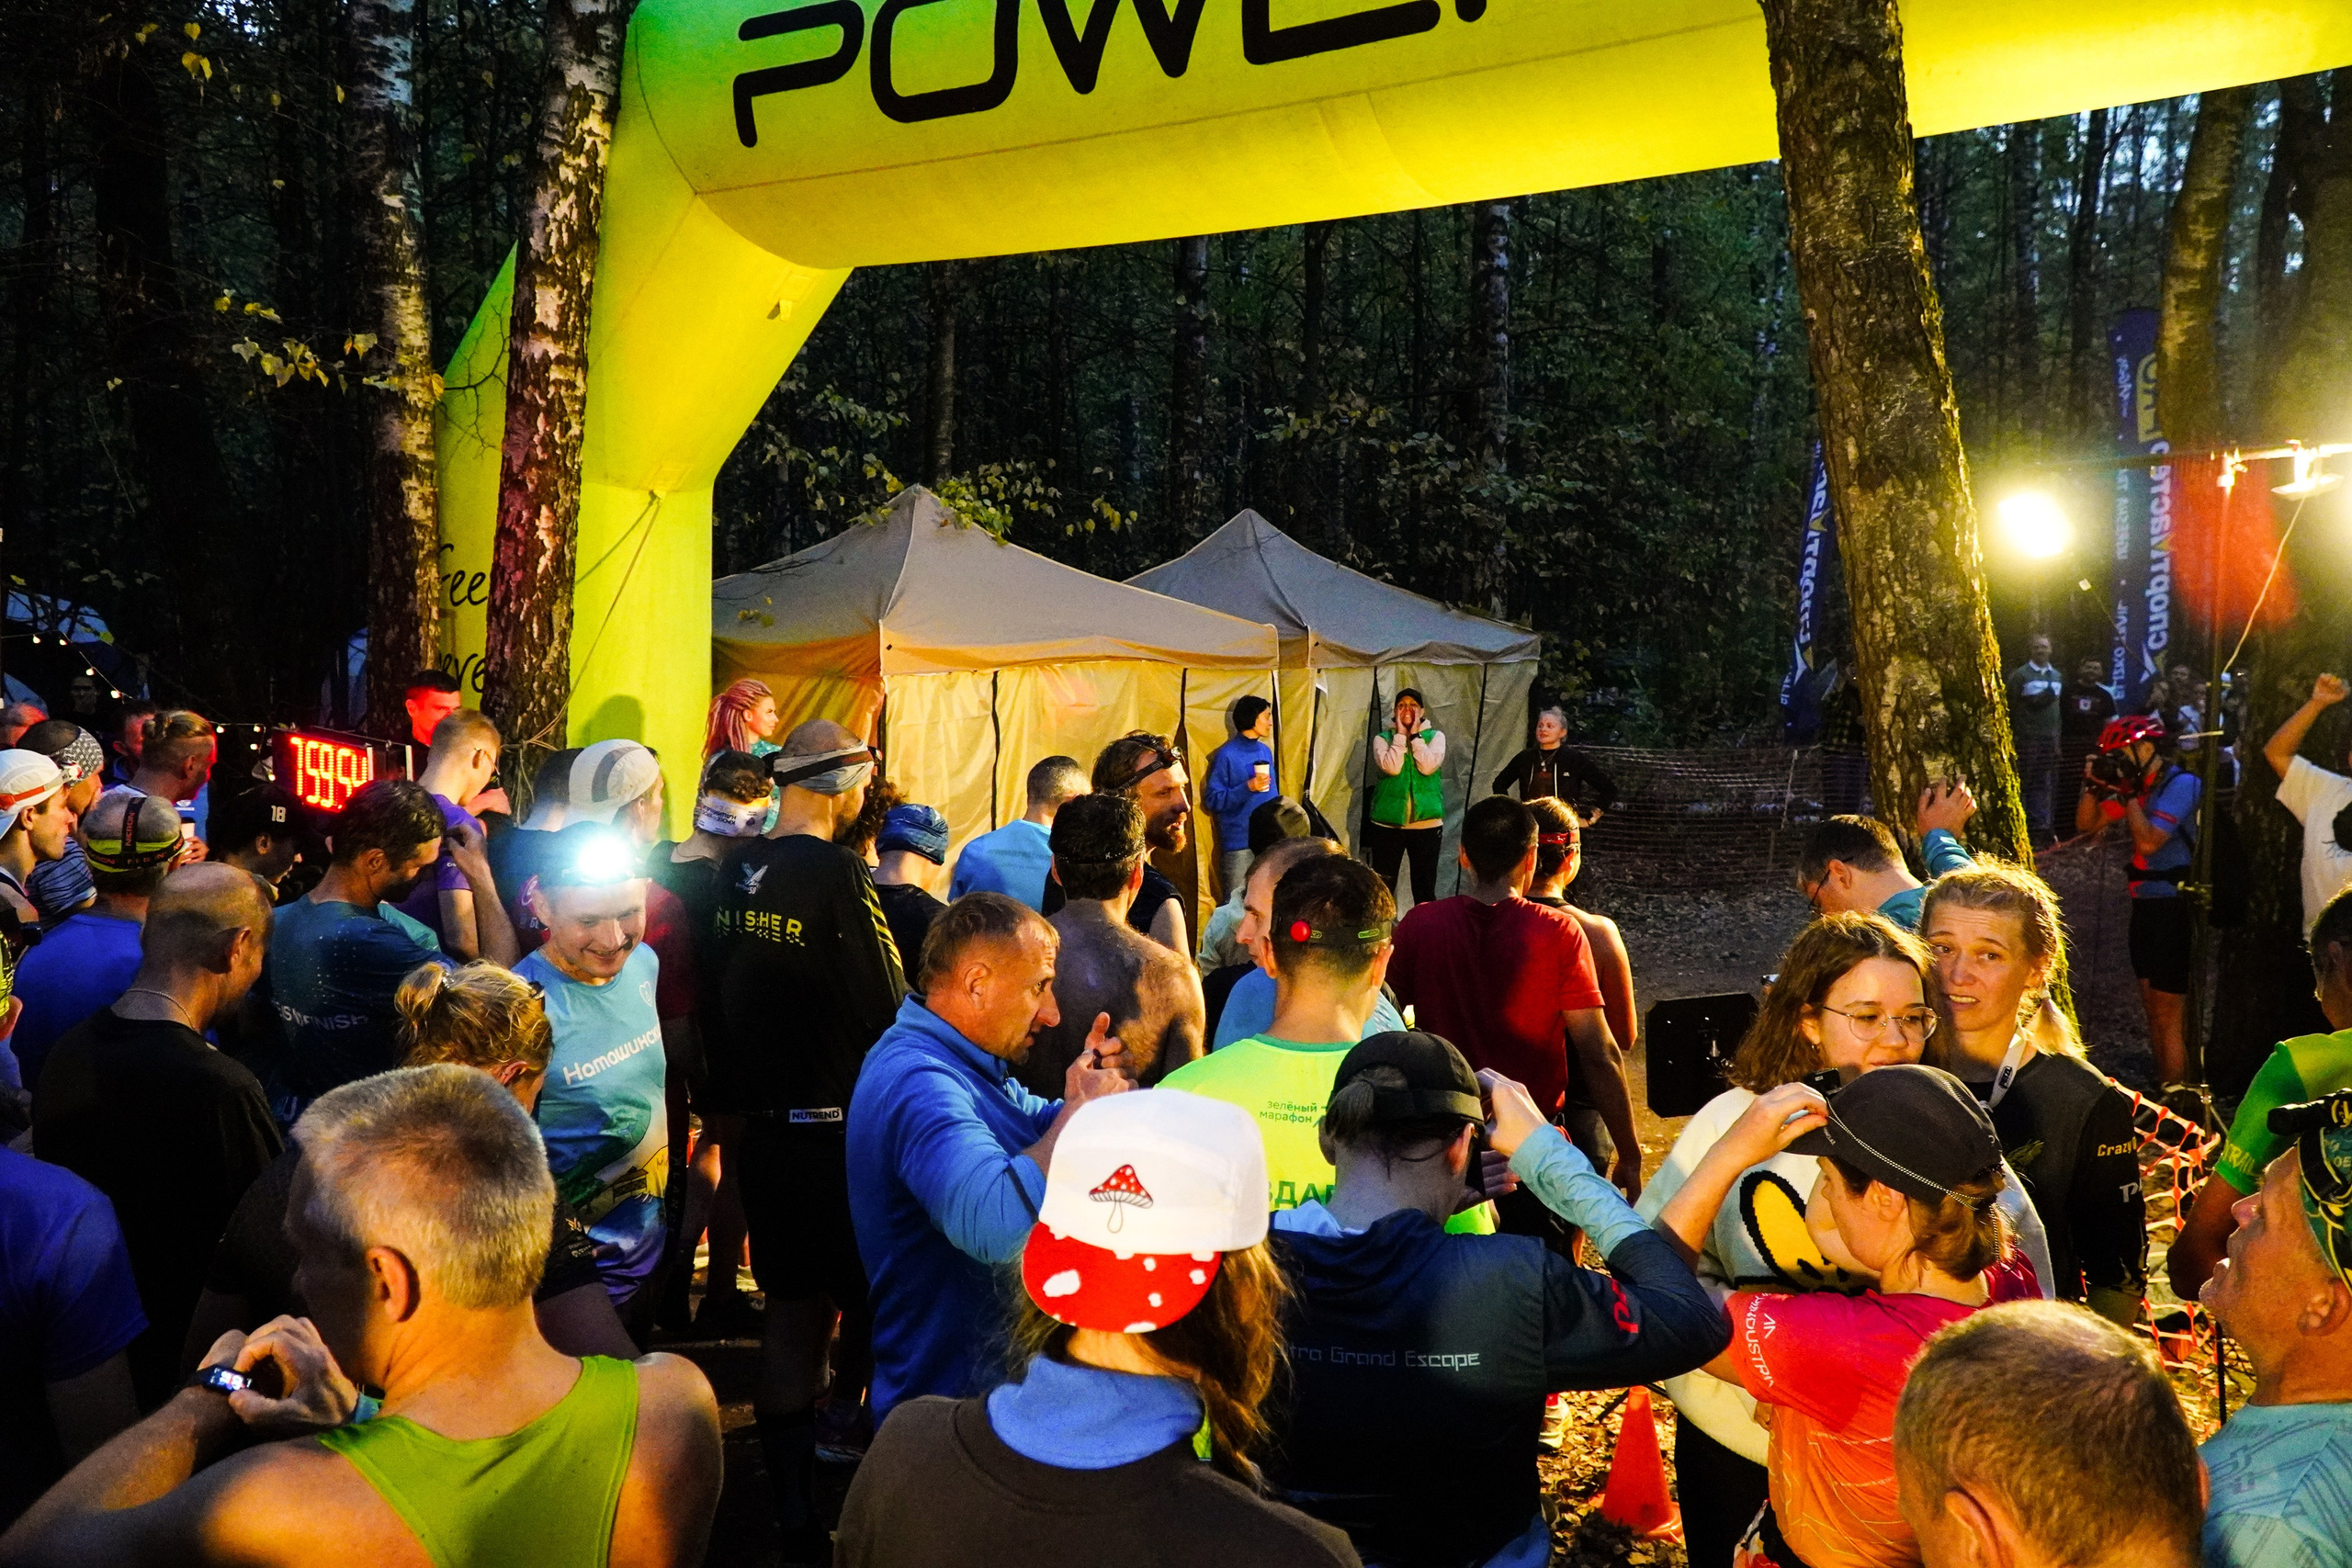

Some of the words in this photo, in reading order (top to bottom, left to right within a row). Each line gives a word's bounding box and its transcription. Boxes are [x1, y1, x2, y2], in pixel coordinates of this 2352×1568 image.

[271, 805, 287, 823] 18
[1267, 1100, 1317, 1113] зелёный
[792, 1109, 840, 1120] NUTREND
[1260, 1111, 1312, 1123] марафон
[1331, 1347, 1396, 1367] Grand
[1405, 1350, 1480, 1372] Escape
